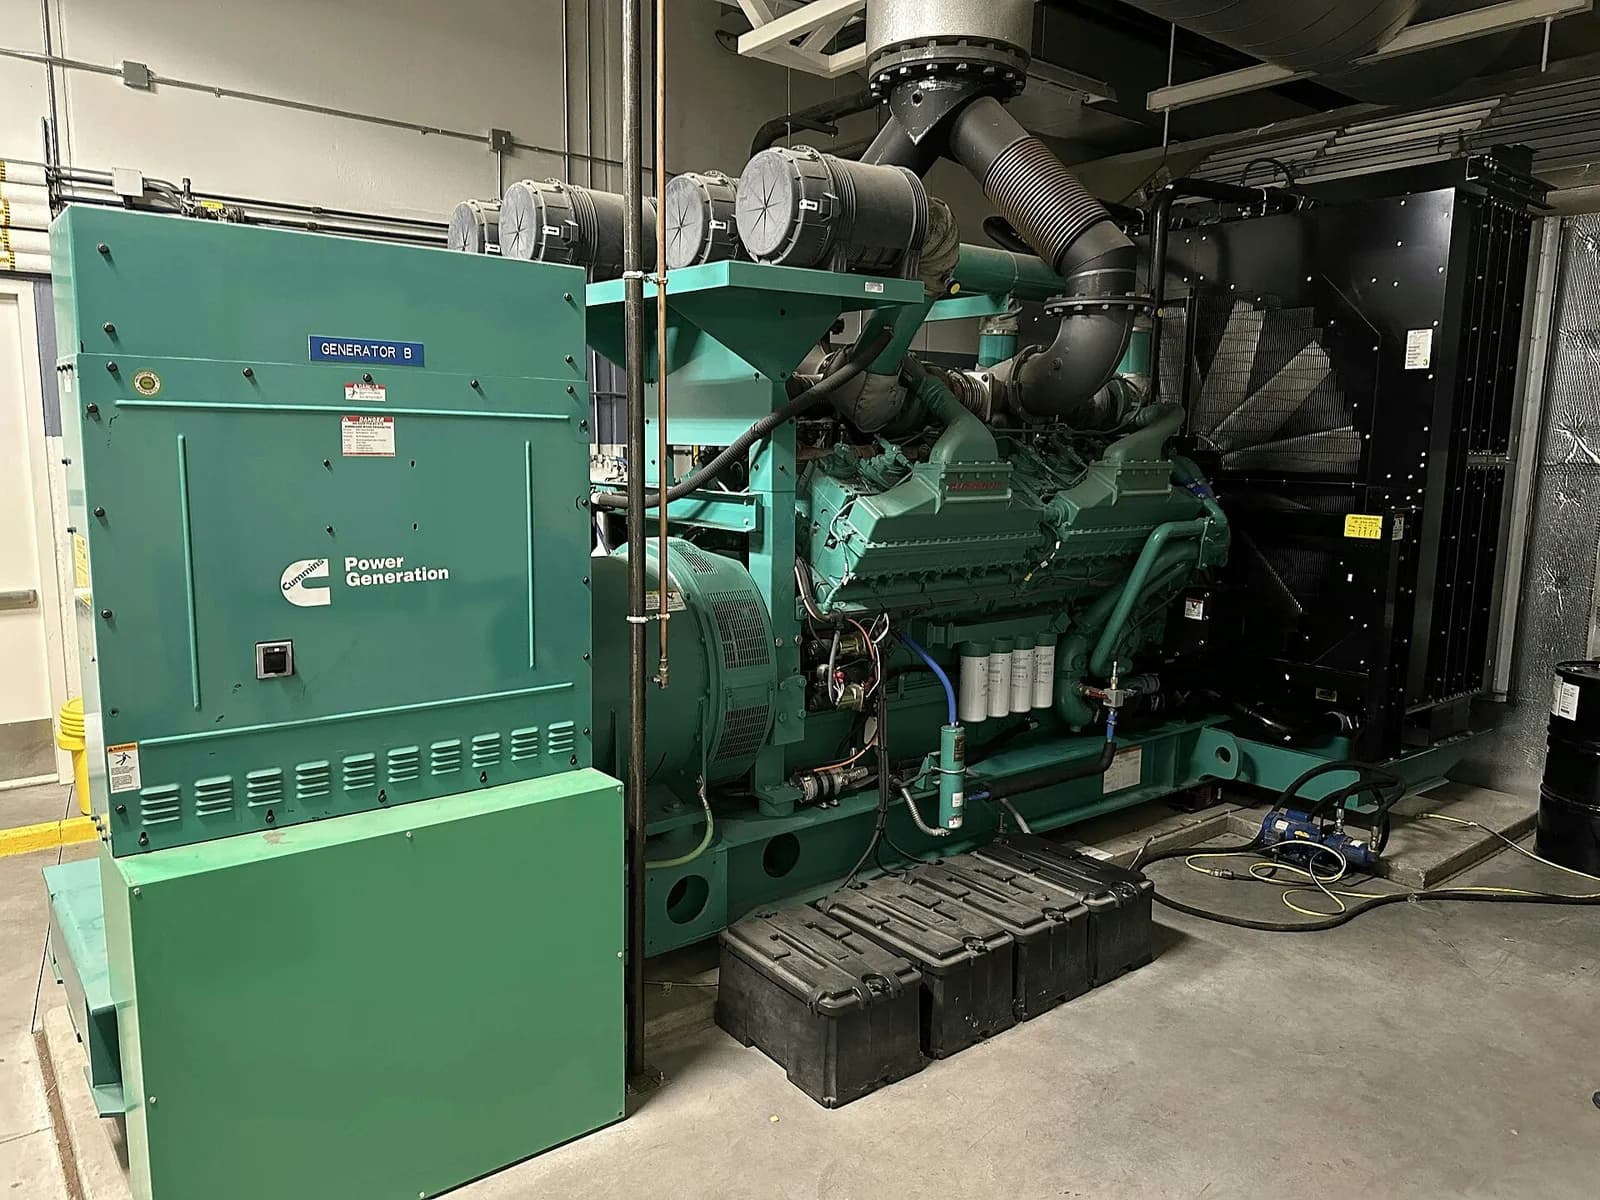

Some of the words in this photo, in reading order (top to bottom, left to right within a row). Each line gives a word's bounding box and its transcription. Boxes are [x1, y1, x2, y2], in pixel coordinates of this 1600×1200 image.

[321, 342, 396, 358] GENERATOR
[404, 347, 412, 359] B
[344, 556, 404, 571] Power
[282, 558, 324, 591] Cummins
[346, 566, 449, 587] Generation
